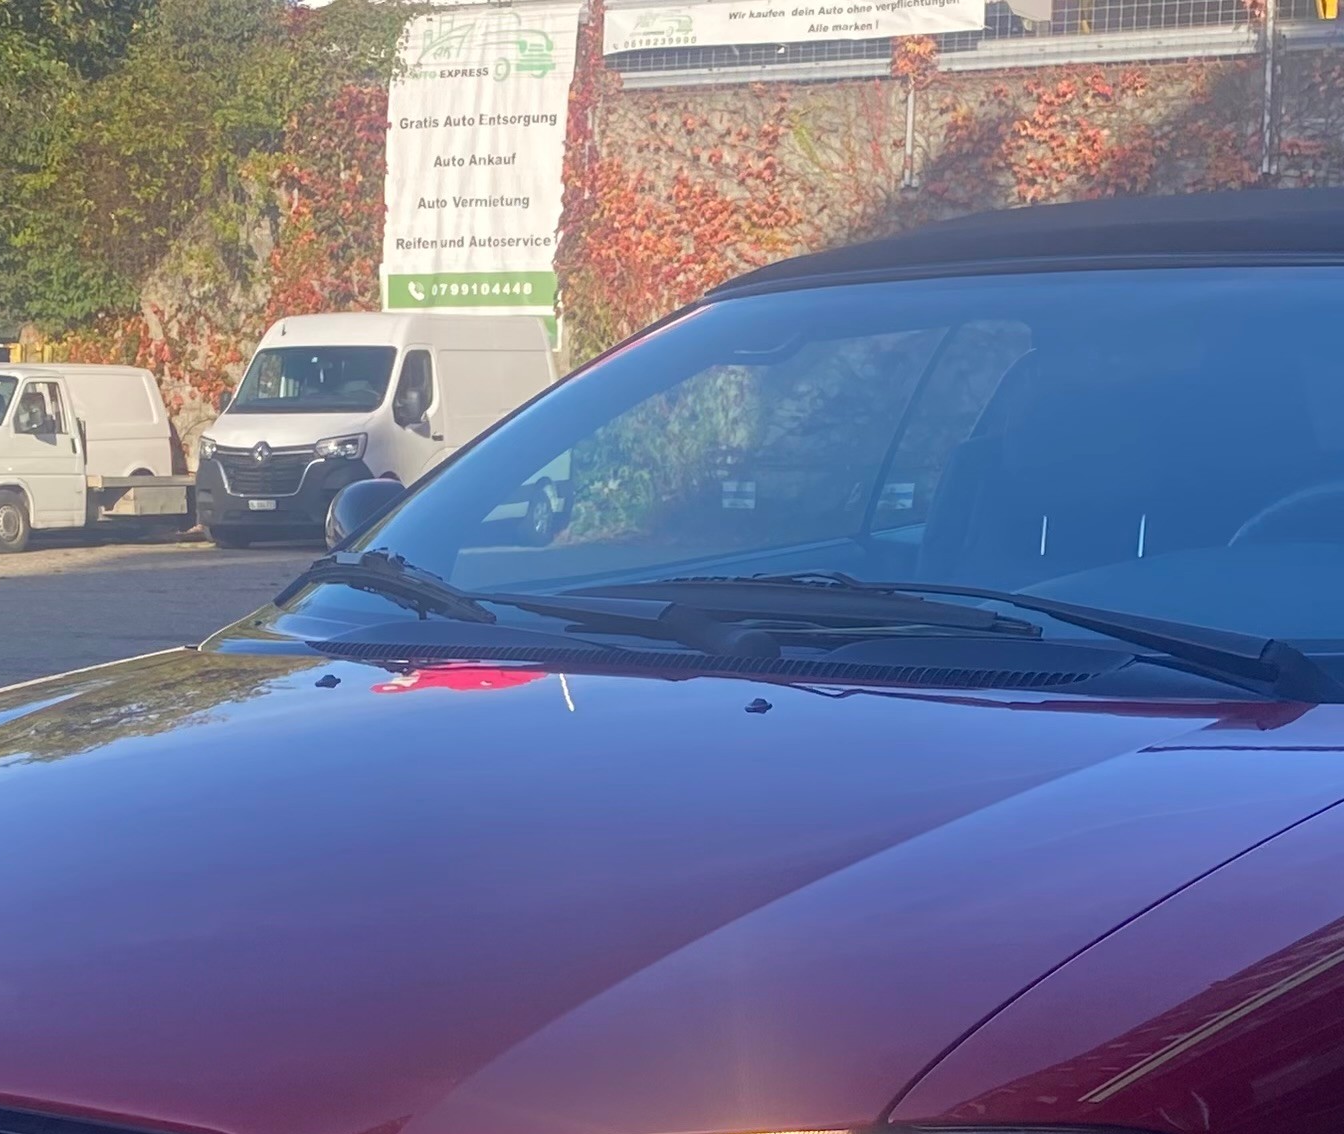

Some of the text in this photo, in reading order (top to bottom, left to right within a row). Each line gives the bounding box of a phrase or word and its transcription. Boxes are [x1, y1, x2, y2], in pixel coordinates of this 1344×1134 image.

[728, 11, 746, 20] Wir
[748, 9, 785, 19] kaufen
[791, 7, 815, 17] dein
[818, 6, 844, 16] Auto
[847, 4, 872, 14] ohne
[808, 23, 829, 33] Alle
[832, 21, 873, 32] marken
[440, 67, 489, 79] EXPRESS
[399, 113, 557, 130] Gratis Auto Entsorgung
[433, 152, 517, 168] Auto Ankauf
[417, 195, 530, 209] Auto Vermietung
[396, 234, 552, 250] Reifen und Autoservice
[431, 282, 533, 296] 0799104448
